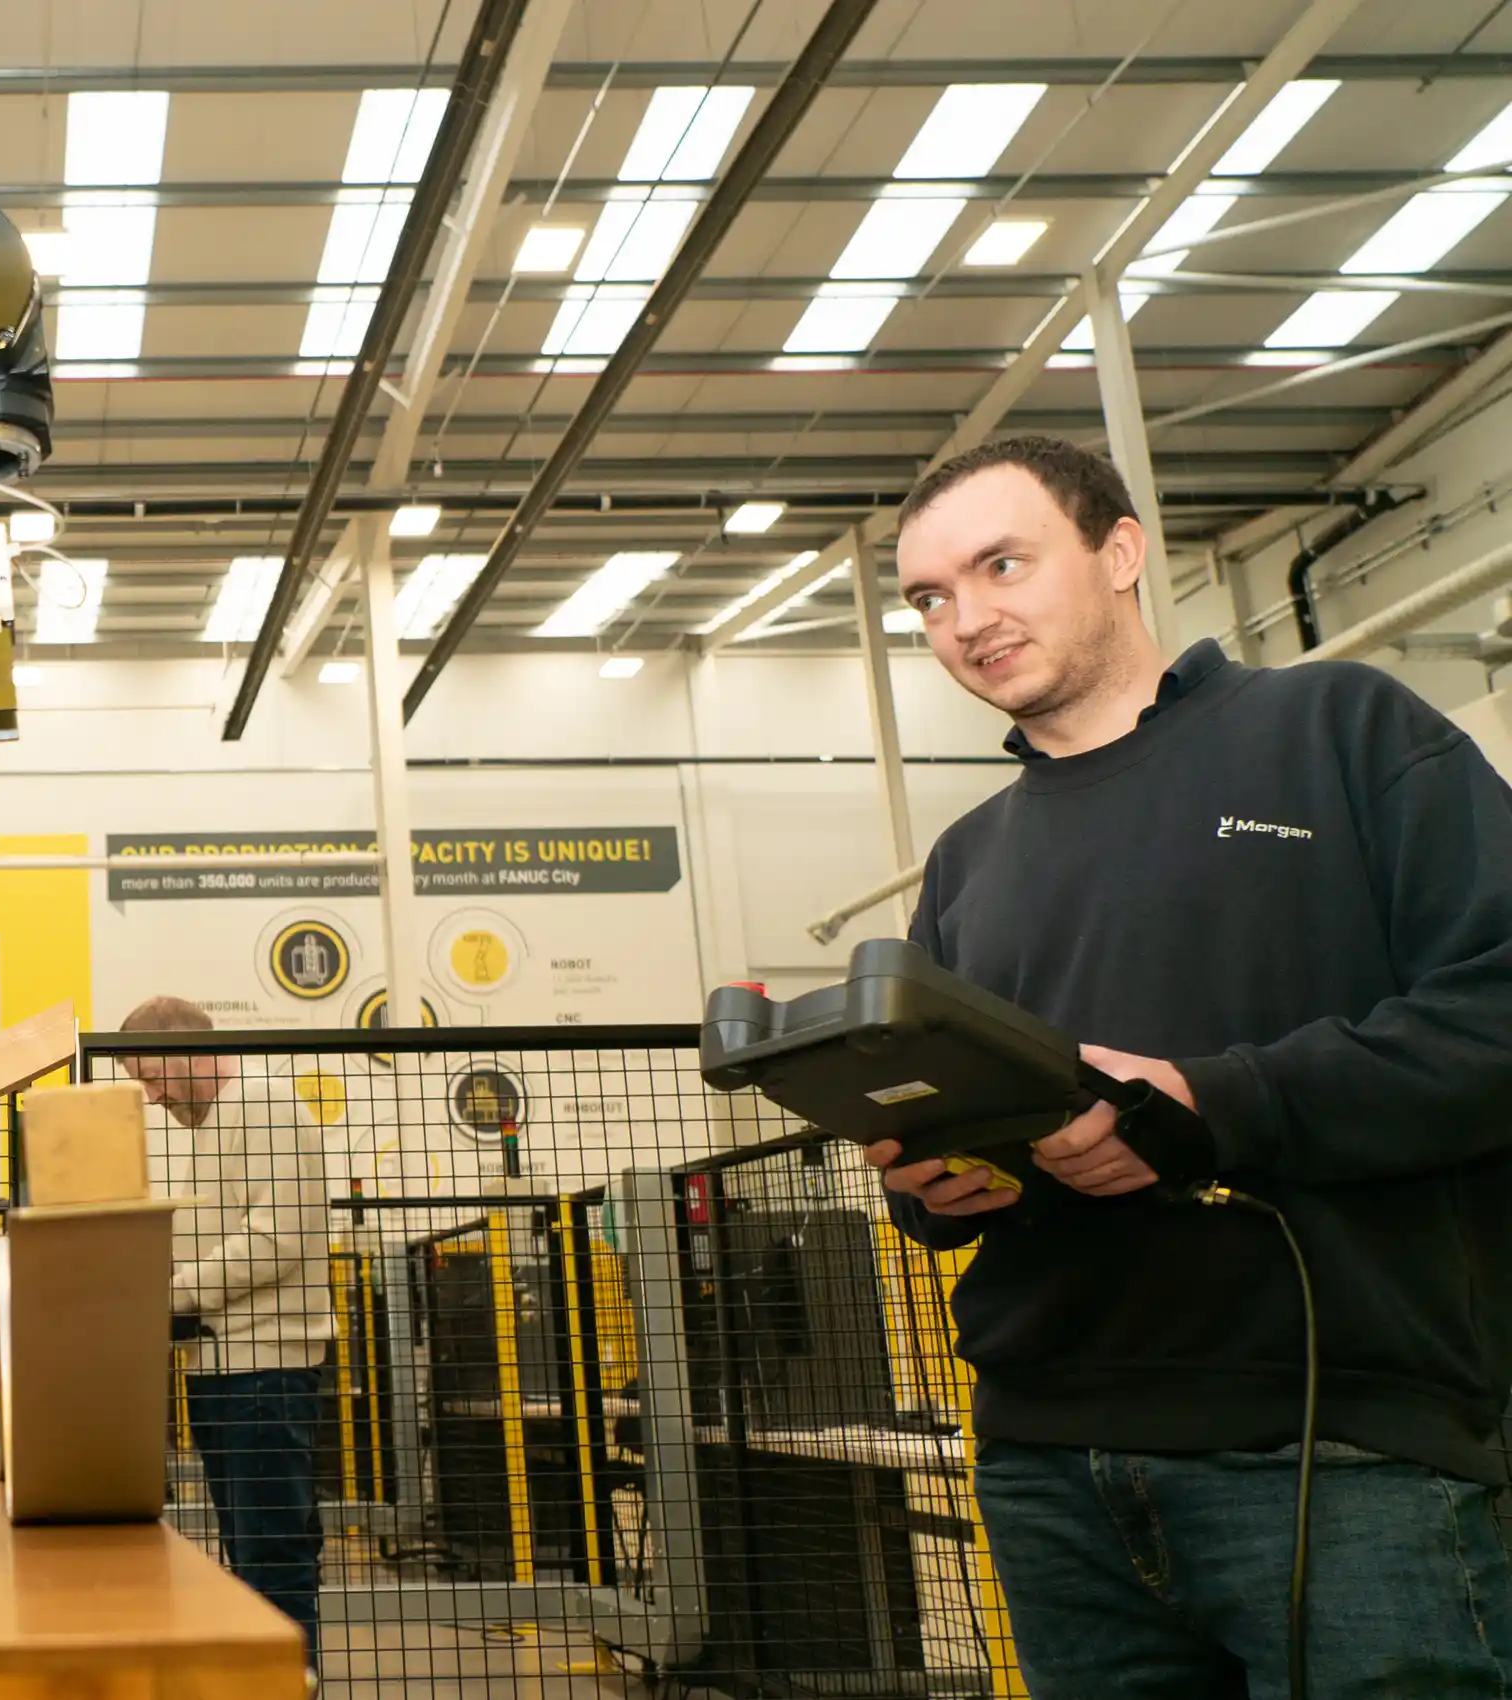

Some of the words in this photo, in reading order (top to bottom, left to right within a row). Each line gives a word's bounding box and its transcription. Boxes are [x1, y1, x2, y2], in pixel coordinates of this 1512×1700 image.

[1236, 819, 1313, 839] Morgan
[367, 840, 497, 864] PACITY
[504, 840, 531, 863] IS
[538, 838, 651, 863] UNIQUE!
[121, 878, 159, 890] more
[162, 875, 193, 889] than
[198, 873, 255, 890] 350,000
[258, 873, 293, 888] units
[296, 875, 320, 888] are
[323, 872, 379, 889] produce
[432, 870, 478, 885] month
[481, 871, 496, 885] at
[498, 869, 549, 885] FANUC
[552, 869, 580, 886] City
[550, 959, 591, 970] ROBOT
[556, 1013, 582, 1024] CNC
